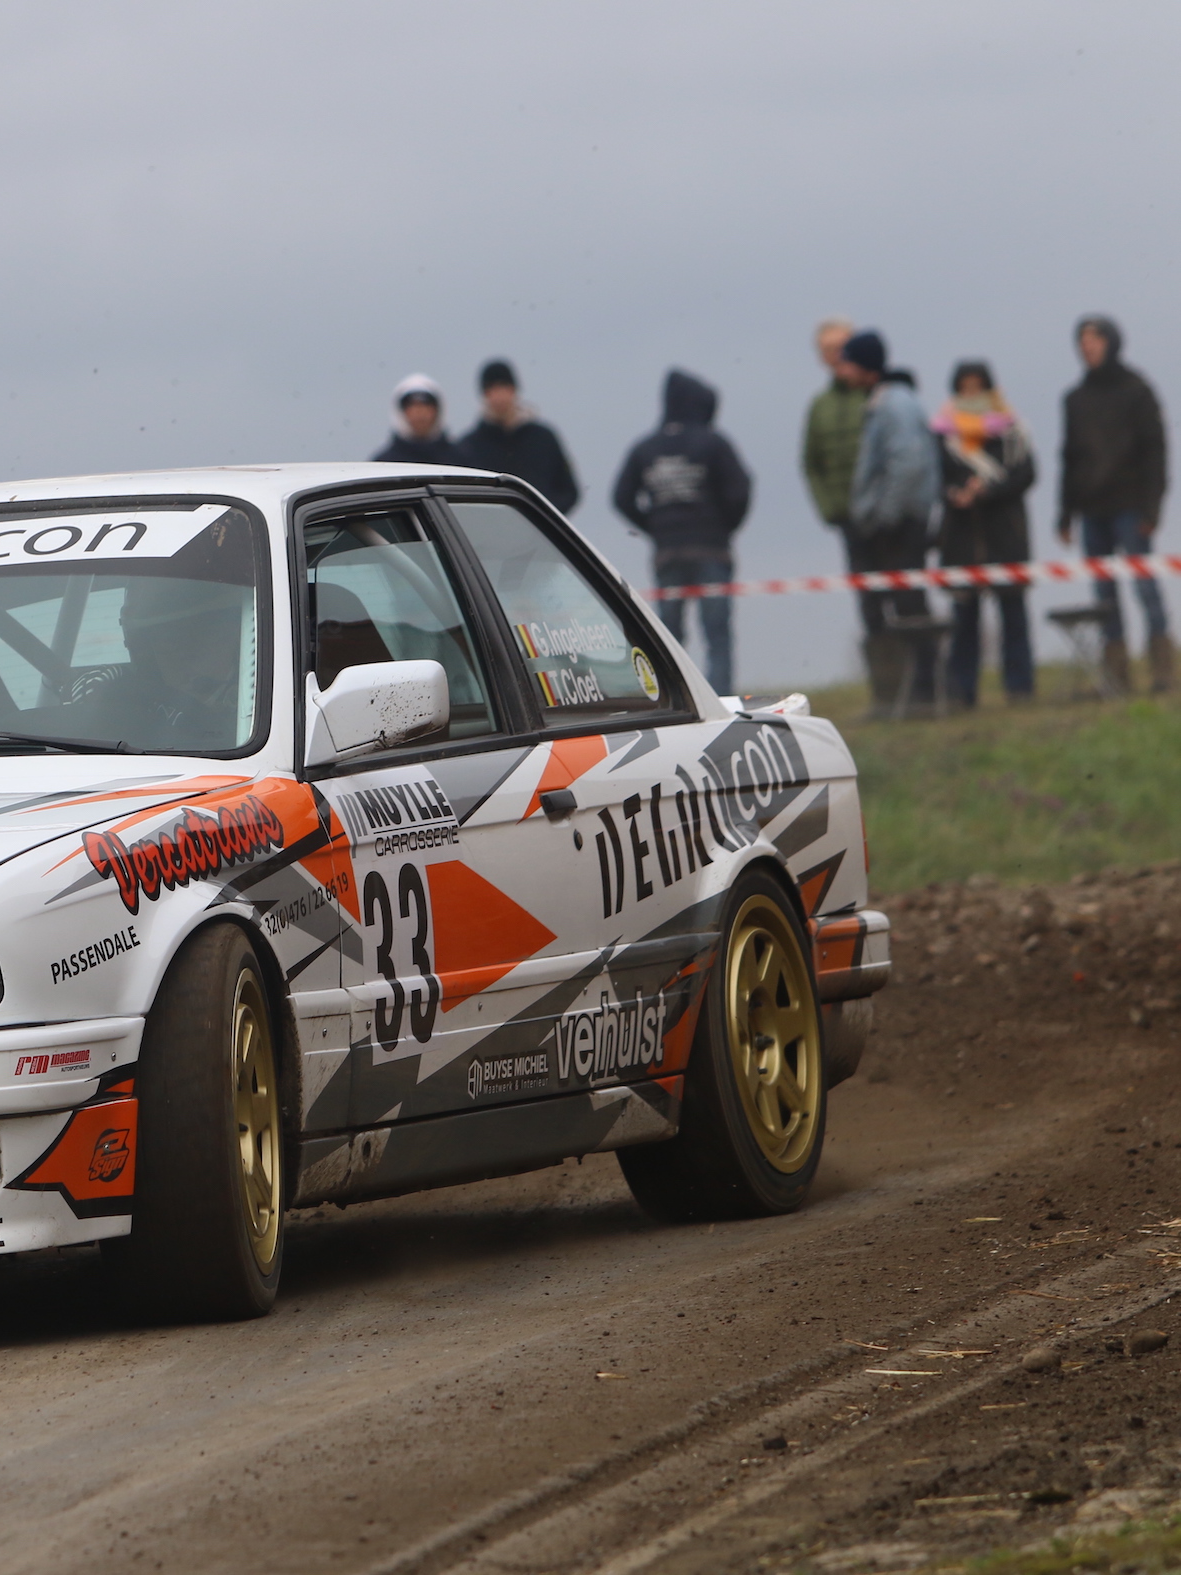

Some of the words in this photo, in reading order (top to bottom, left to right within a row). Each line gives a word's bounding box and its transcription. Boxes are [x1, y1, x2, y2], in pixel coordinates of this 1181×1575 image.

[548, 667, 604, 706] T.Cloet
[354, 780, 453, 828] MUYLLE
[82, 795, 284, 915] Vercatrans
[375, 825, 459, 857] CARROSSERIE
[51, 925, 141, 984] PASSENDALE
[363, 863, 440, 1052] 33
[555, 988, 667, 1080] verhulst
[484, 1059, 513, 1081] BUYSE
[514, 1054, 548, 1076] MICHIEL
